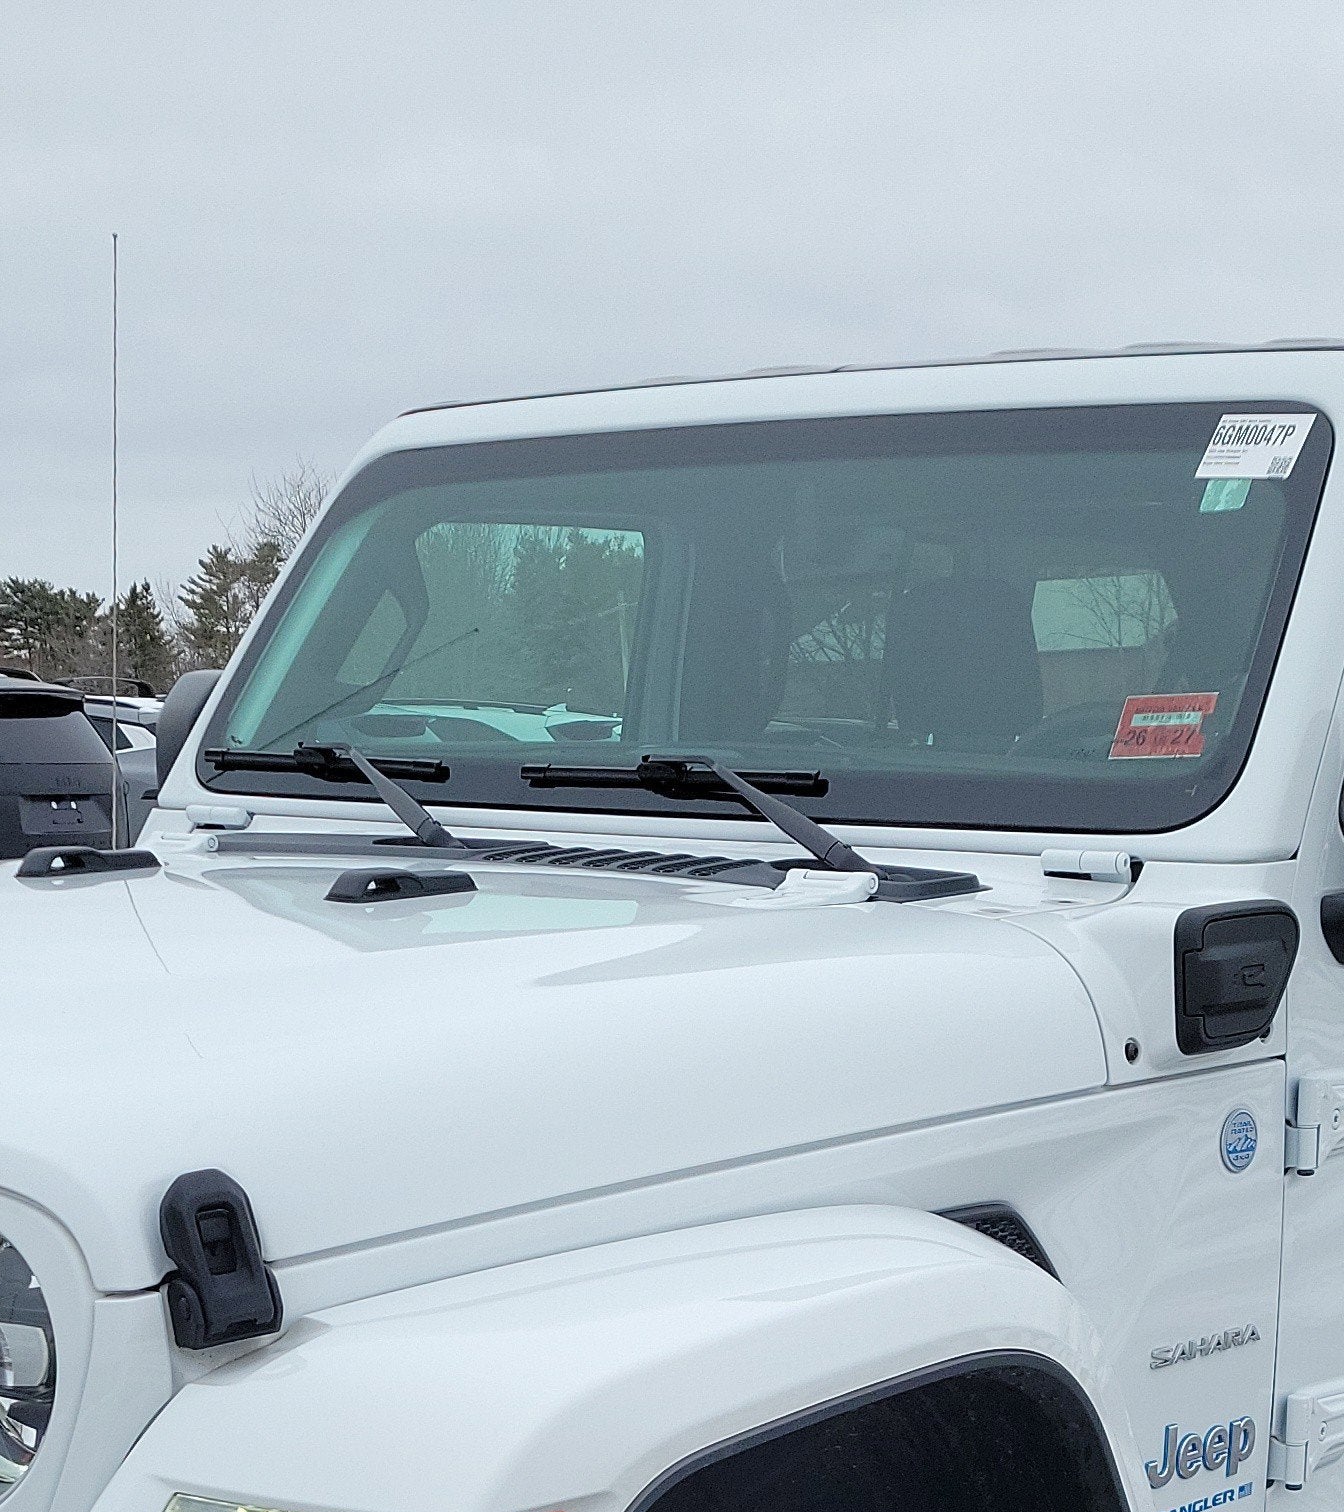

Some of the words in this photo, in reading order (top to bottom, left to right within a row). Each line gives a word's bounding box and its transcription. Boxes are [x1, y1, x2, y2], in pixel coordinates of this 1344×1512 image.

[1211, 424, 1297, 446] 6GM0047P
[1149, 1323, 1261, 1370] SAHARA
[1144, 1415, 1256, 1489] Jeep
